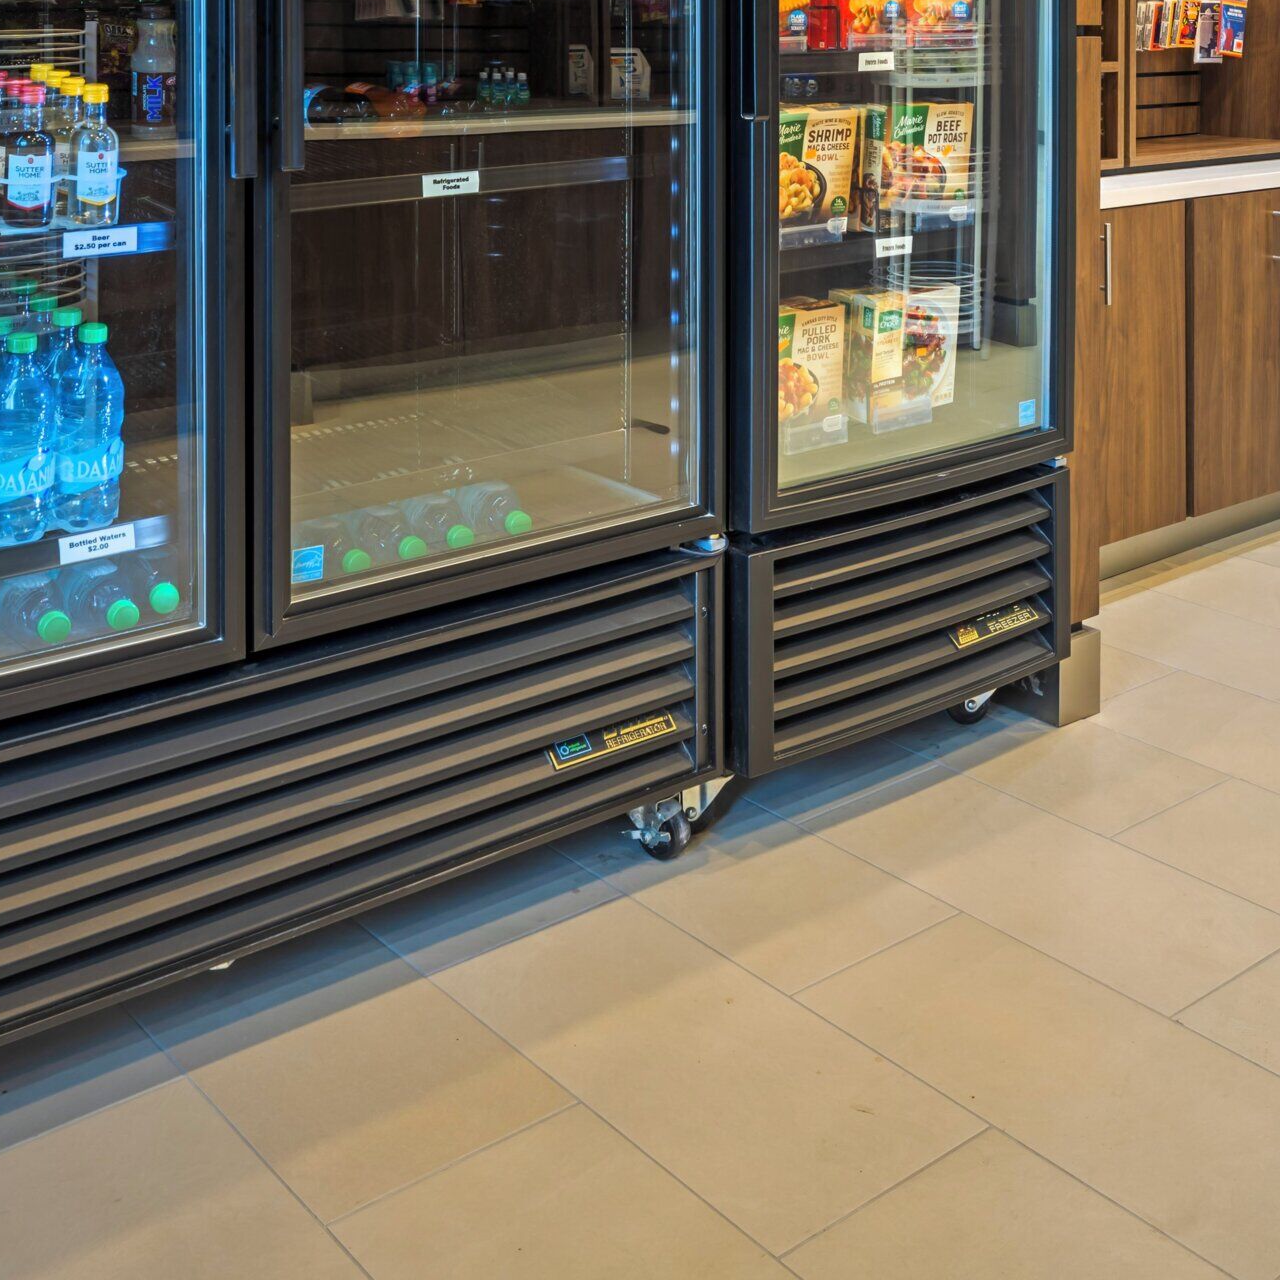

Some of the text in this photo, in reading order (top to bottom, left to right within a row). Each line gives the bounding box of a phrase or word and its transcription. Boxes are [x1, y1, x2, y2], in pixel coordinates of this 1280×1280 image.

[146, 75, 163, 123] MILK
[897, 115, 924, 130] Marie
[936, 120, 961, 132] BEEF
[808, 128, 852, 143] SHRIMP
[927, 132, 968, 144] POT ROAST
[807, 143, 850, 152] MAC CHEESE
[816, 154, 839, 162] BOWL
[15, 165, 45, 173] SUTTER
[432, 175, 469, 185] Refrigerated
[442, 183, 460, 191] Foods
[92, 234, 110, 242] Beer
[74, 243, 95, 251] $2.50
[802, 324, 836, 338] PULLED
[806, 334, 831, 346] PORK
[818, 342, 839, 351] CHEESE
[807, 352, 829, 361] BOWL
[69, 531, 126, 549] Bottled Waters
[87, 543, 109, 553] $2.00
[988, 613, 1031, 633] FREEZER
[605, 721, 667, 749] REFRIGERATOR
